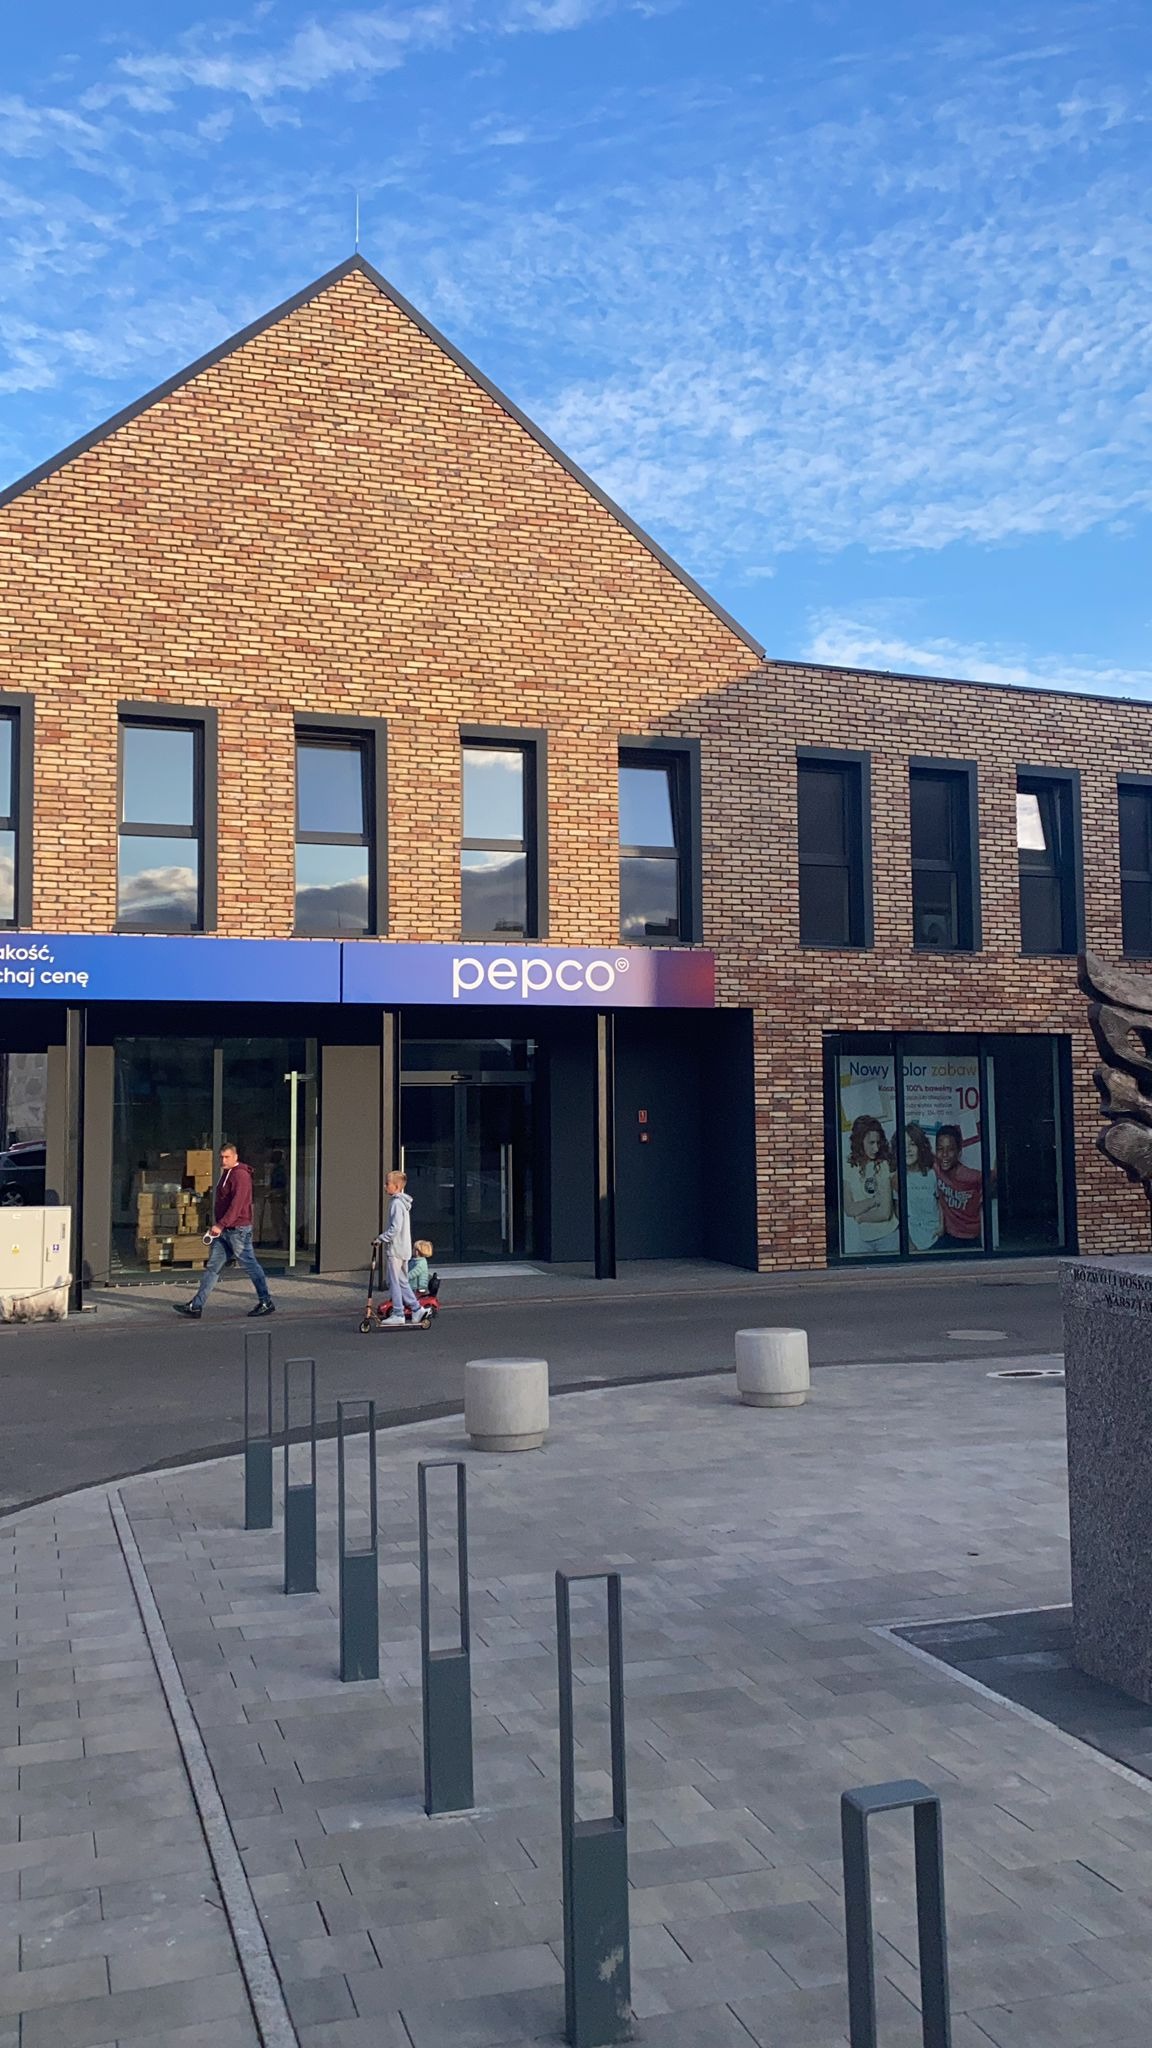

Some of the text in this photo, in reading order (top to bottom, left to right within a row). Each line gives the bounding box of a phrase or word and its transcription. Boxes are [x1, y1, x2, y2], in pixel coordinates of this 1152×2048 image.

[0, 967, 88, 987] haj cenę
[453, 957, 615, 998] pepco
[849, 1062, 889, 1079] Nowy
[902, 1061, 927, 1077] olor
[955, 1086, 979, 1110] 10
